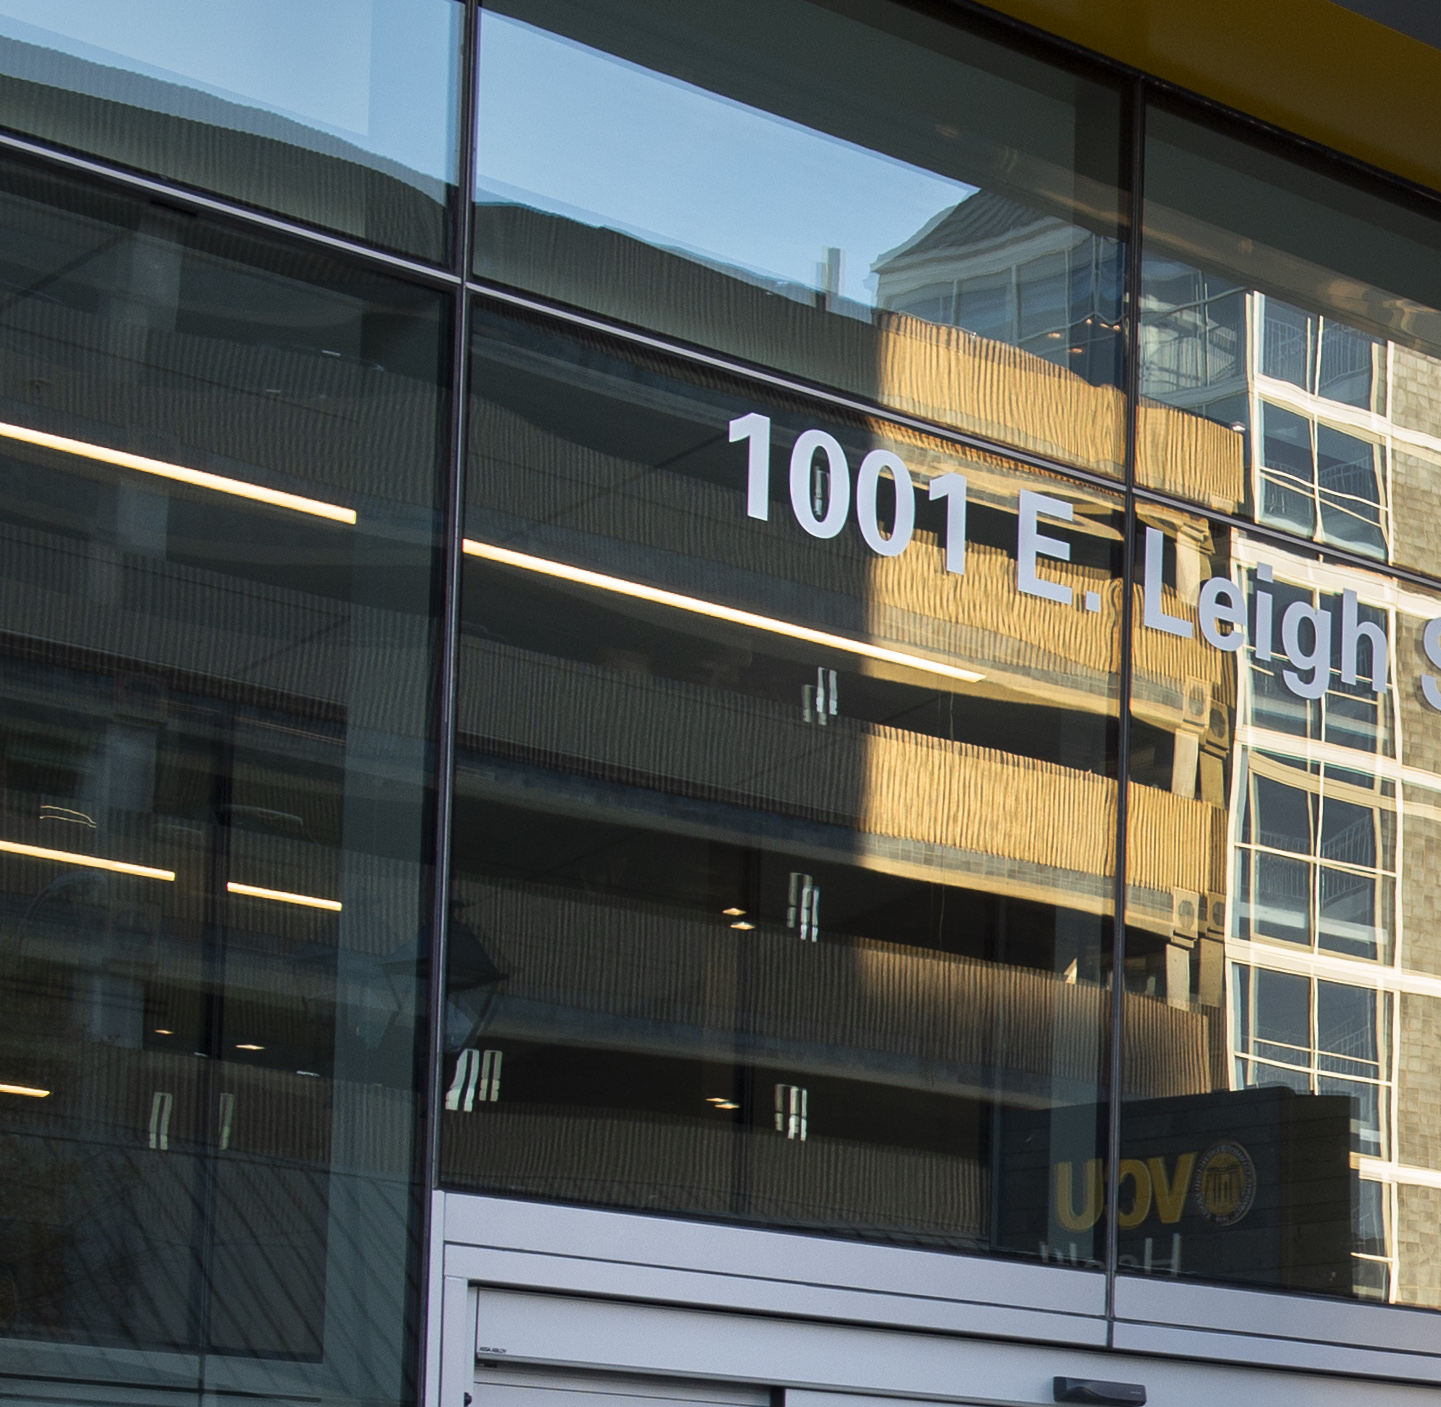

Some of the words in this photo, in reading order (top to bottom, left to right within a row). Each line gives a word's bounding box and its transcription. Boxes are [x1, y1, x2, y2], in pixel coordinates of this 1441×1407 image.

[728, 411, 968, 576] 1001
[1017, 488, 1101, 614] E.
[1144, 526, 1389, 700] Leigh
